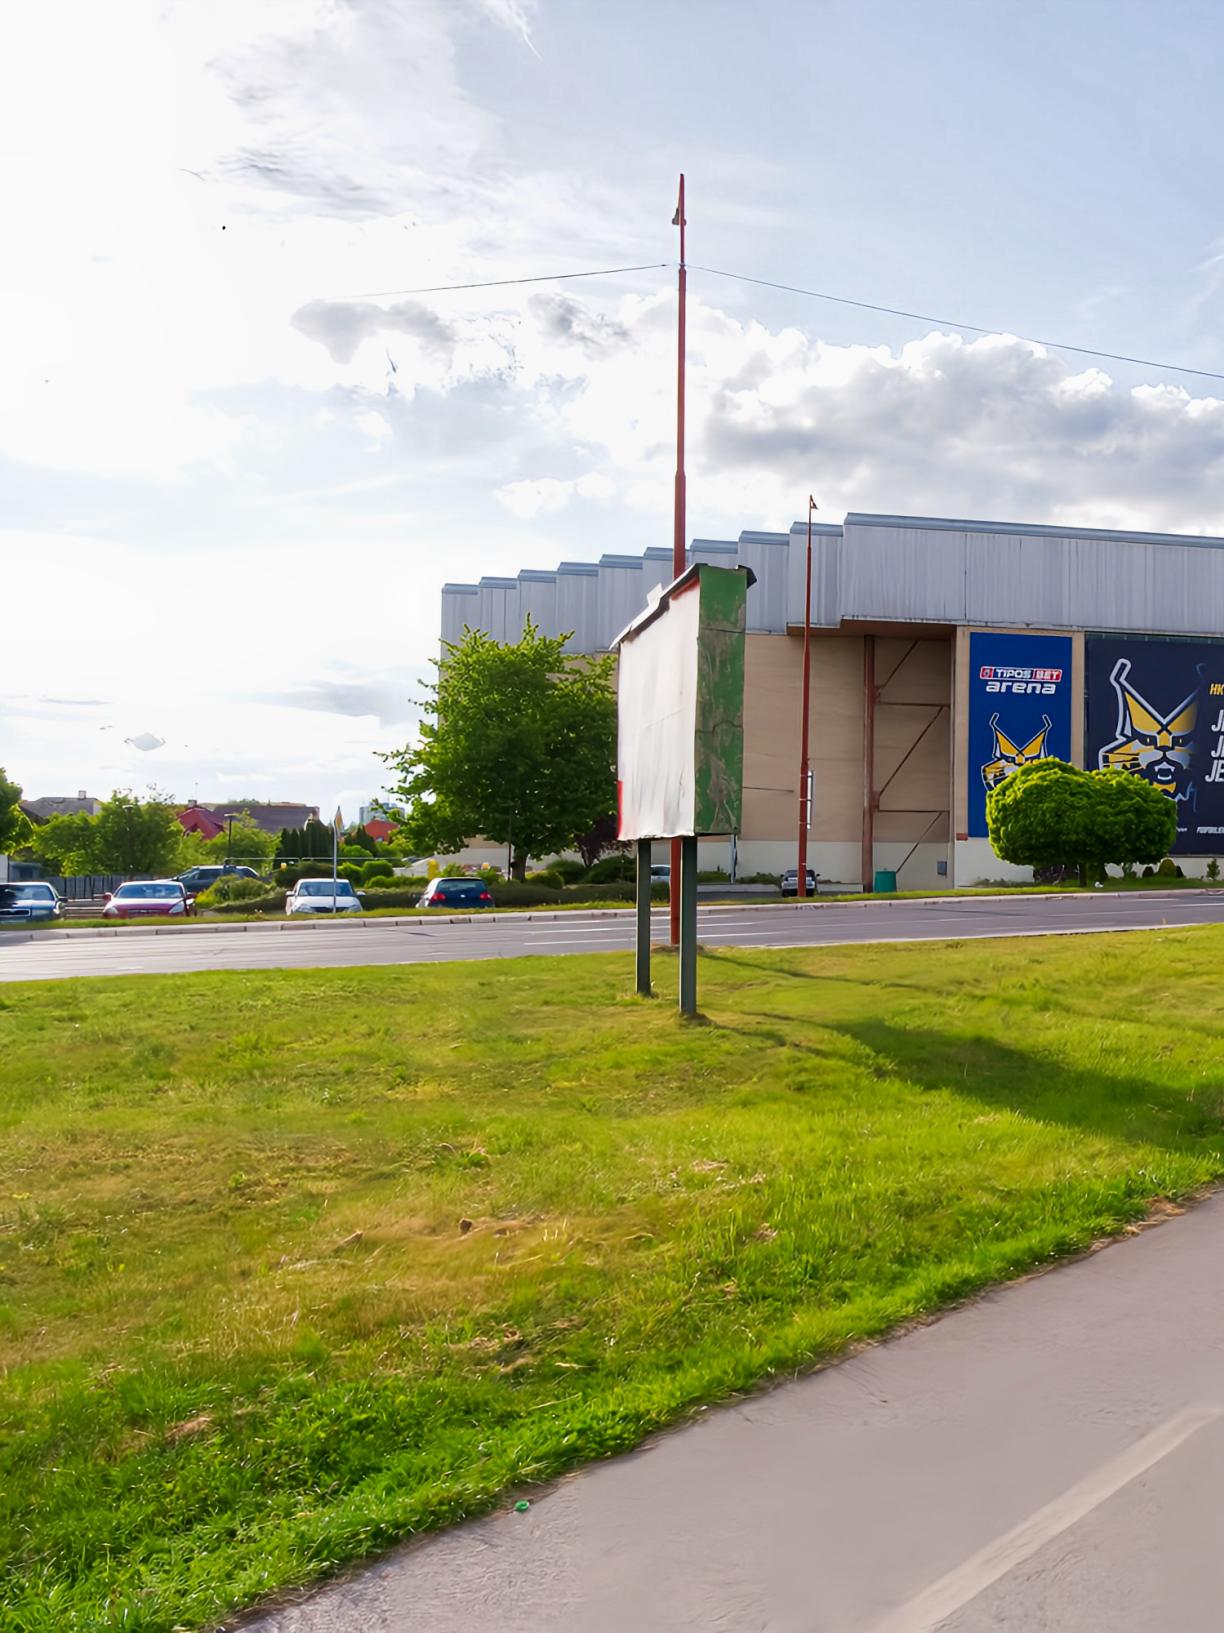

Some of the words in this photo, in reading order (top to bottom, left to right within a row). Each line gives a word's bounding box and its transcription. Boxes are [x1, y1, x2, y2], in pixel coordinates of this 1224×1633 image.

[996, 669, 1031, 679] TIPOS
[985, 681, 1056, 695] arena
[1209, 683, 1224, 696] HK
